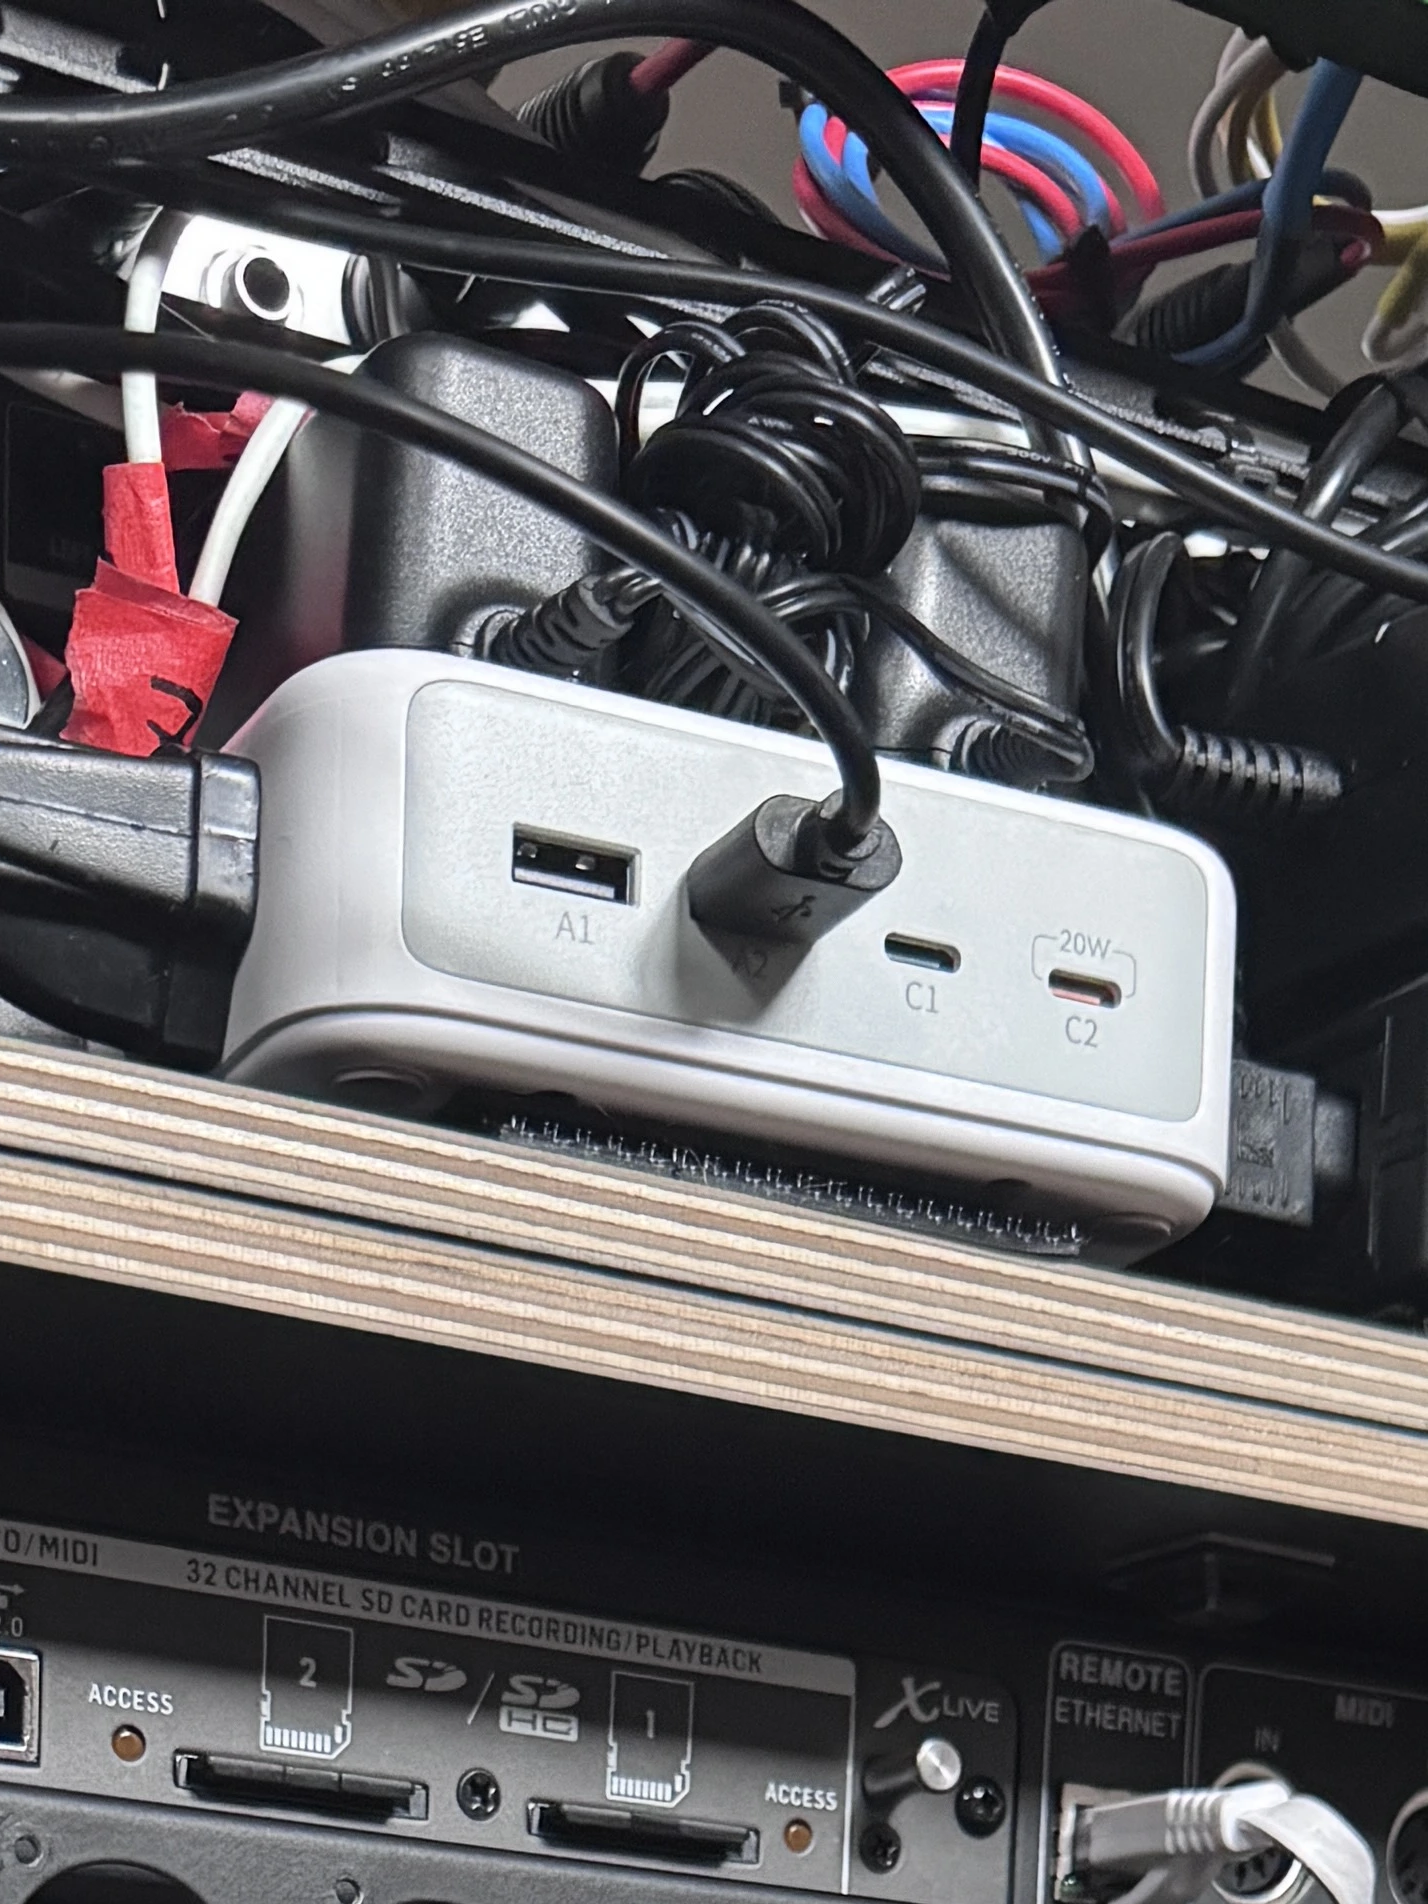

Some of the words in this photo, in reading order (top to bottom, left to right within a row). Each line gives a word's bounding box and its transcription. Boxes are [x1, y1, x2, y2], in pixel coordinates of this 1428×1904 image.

[556, 911, 594, 947] A1
[1058, 928, 1111, 959] 20W
[904, 980, 939, 1015] C1
[1064, 1014, 1100, 1049] C2
[207, 1493, 417, 1559] EXPANSION
[427, 1533, 521, 1577] SLOT
[186, 1557, 219, 1586] 32
[225, 1564, 351, 1612] CHANNEL
[360, 1588, 393, 1616] SD
[401, 1594, 471, 1630] CARD
[477, 1609, 765, 1676] RECORDING/PLAYBACK
[298, 1655, 318, 1689] 2
[1058, 1652, 1184, 1697] REMOTE
[87, 1682, 174, 1716] ACCESS
[645, 1708, 656, 1740] 1
[1054, 1698, 1183, 1740] ETHERNET
[1254, 1726, 1281, 1753] IN
[764, 1782, 839, 1812] ACCESS
